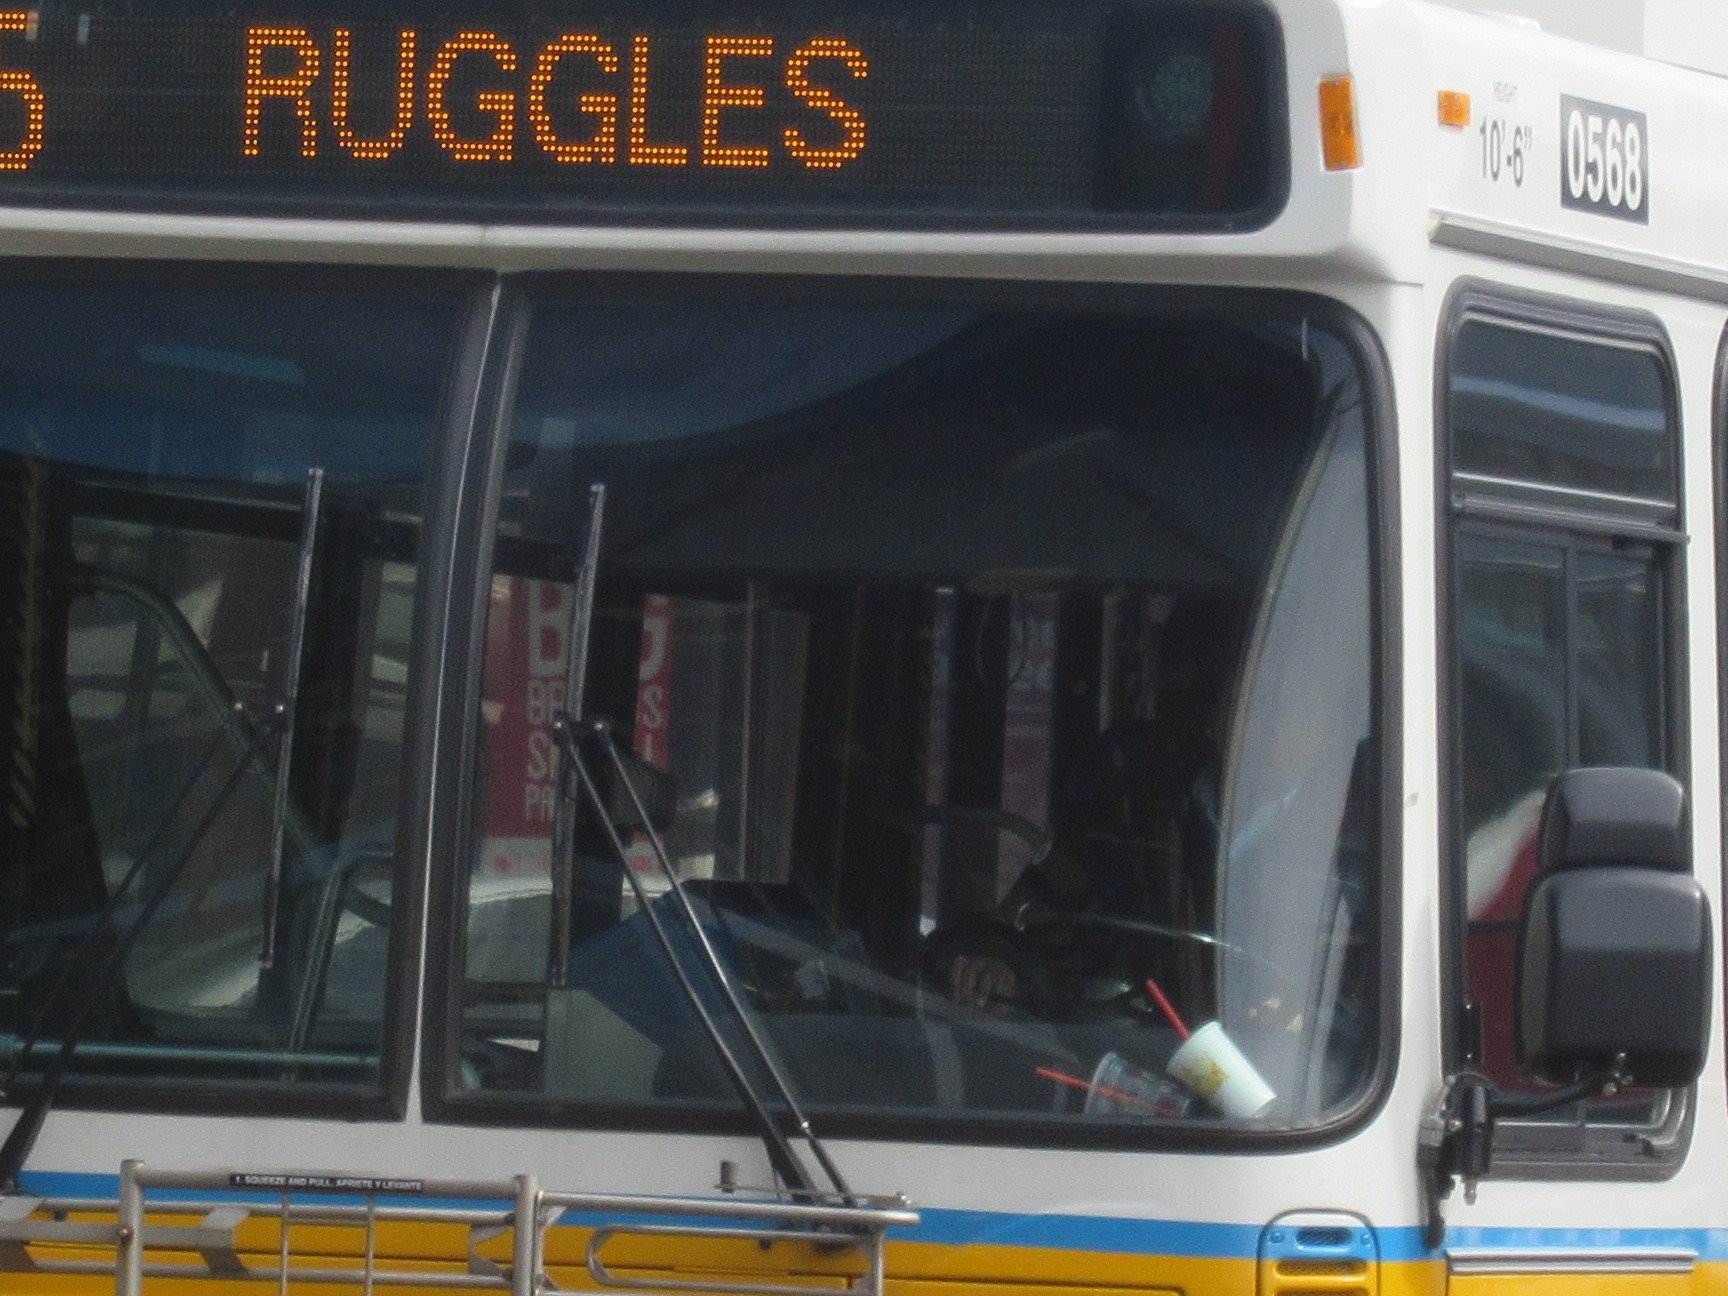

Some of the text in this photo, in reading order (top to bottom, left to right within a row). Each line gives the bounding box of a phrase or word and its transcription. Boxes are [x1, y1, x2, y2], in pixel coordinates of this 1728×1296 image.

[243, 27, 871, 170] RUGGLES
[1567, 110, 1643, 211] 0568
[289, 1176, 308, 1186] AND
